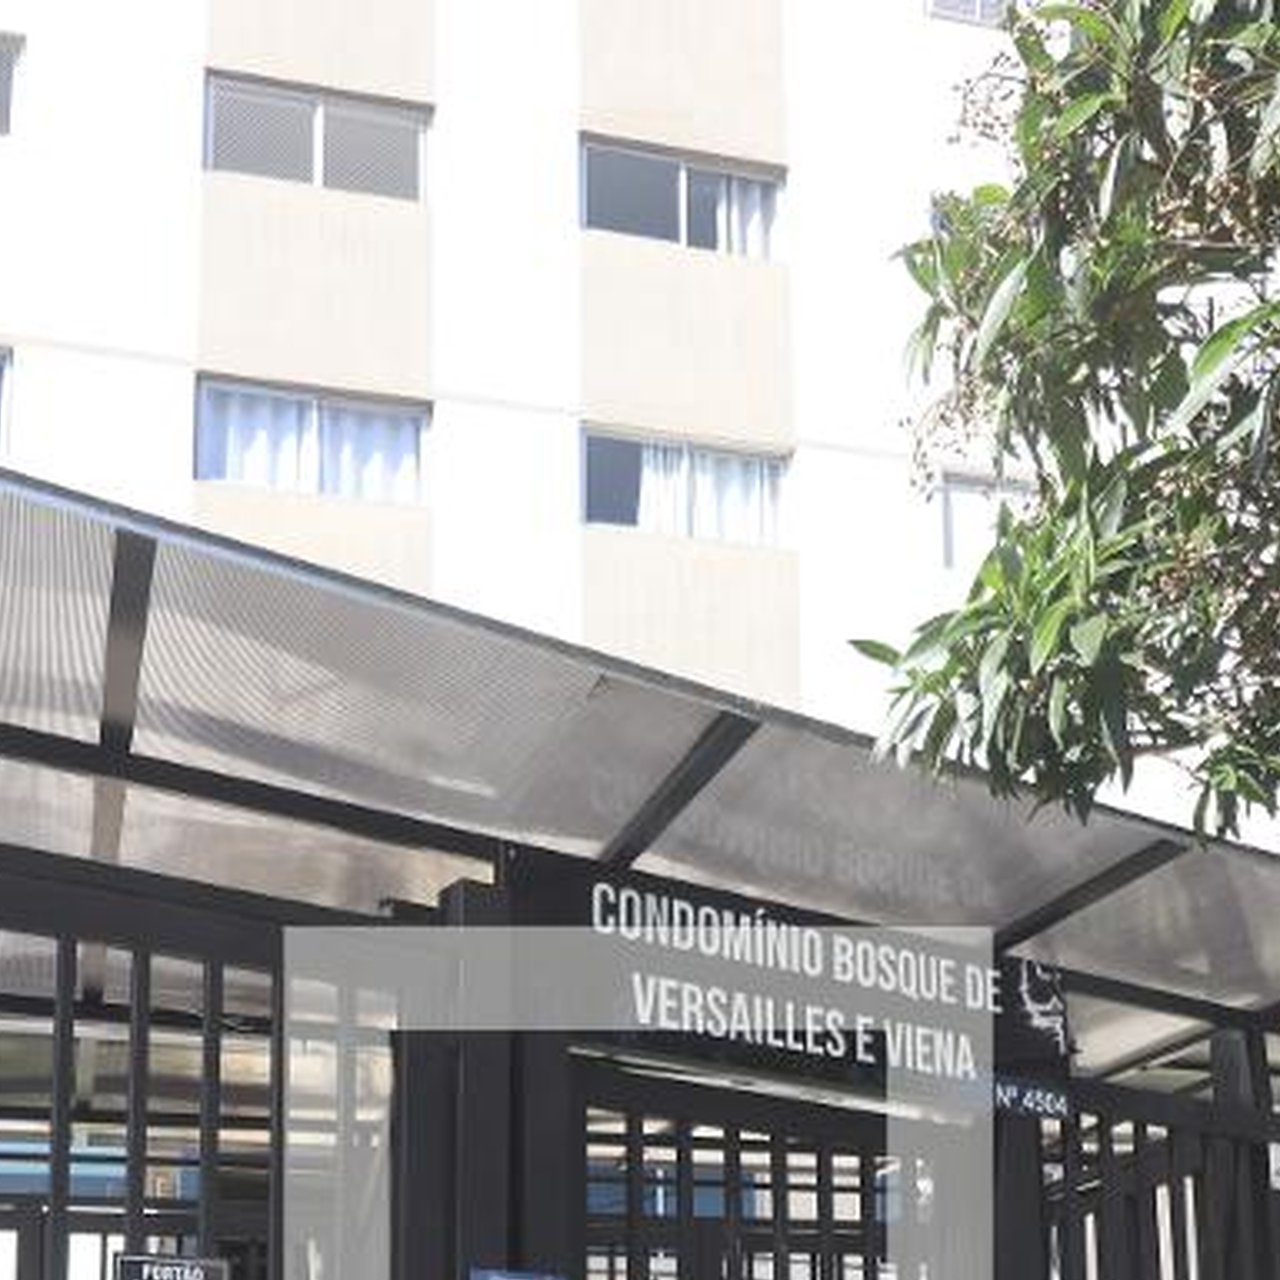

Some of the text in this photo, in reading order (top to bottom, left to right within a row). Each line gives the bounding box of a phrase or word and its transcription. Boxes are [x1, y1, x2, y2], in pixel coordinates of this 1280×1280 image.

[592, 881, 1003, 1014] CONDOMÍNIO BOSQUE DE
[632, 972, 977, 1080] VERSAILLES E VIENA
[1022, 1089, 1068, 1116] 4504
